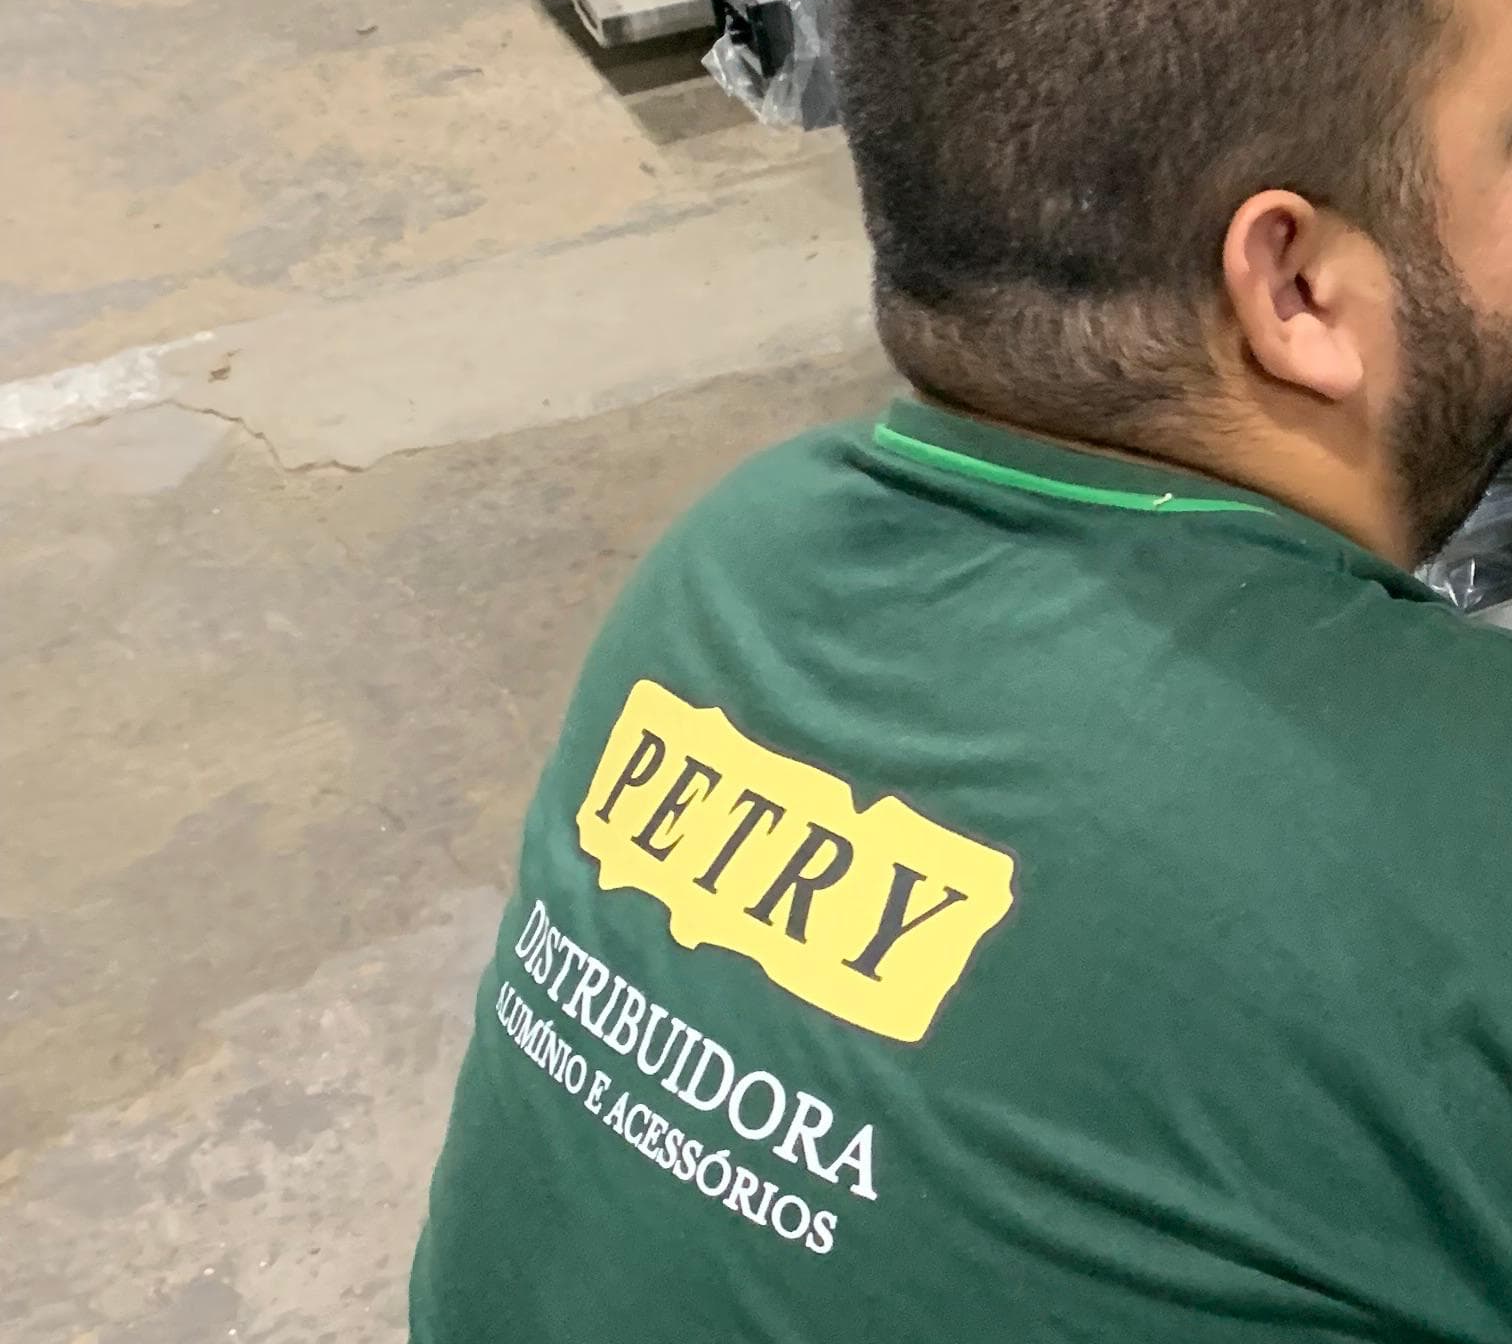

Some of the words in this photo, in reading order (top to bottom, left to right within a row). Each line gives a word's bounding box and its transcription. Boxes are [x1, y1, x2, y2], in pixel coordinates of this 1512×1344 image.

[595, 729, 968, 982] PETRY
[496, 981, 588, 1096] ALUMÍNIO
[585, 1069, 612, 1114] E
[603, 1092, 839, 1256] ACESSÓRIOS
[515, 899, 880, 1202] DISTRIBUIDORA
